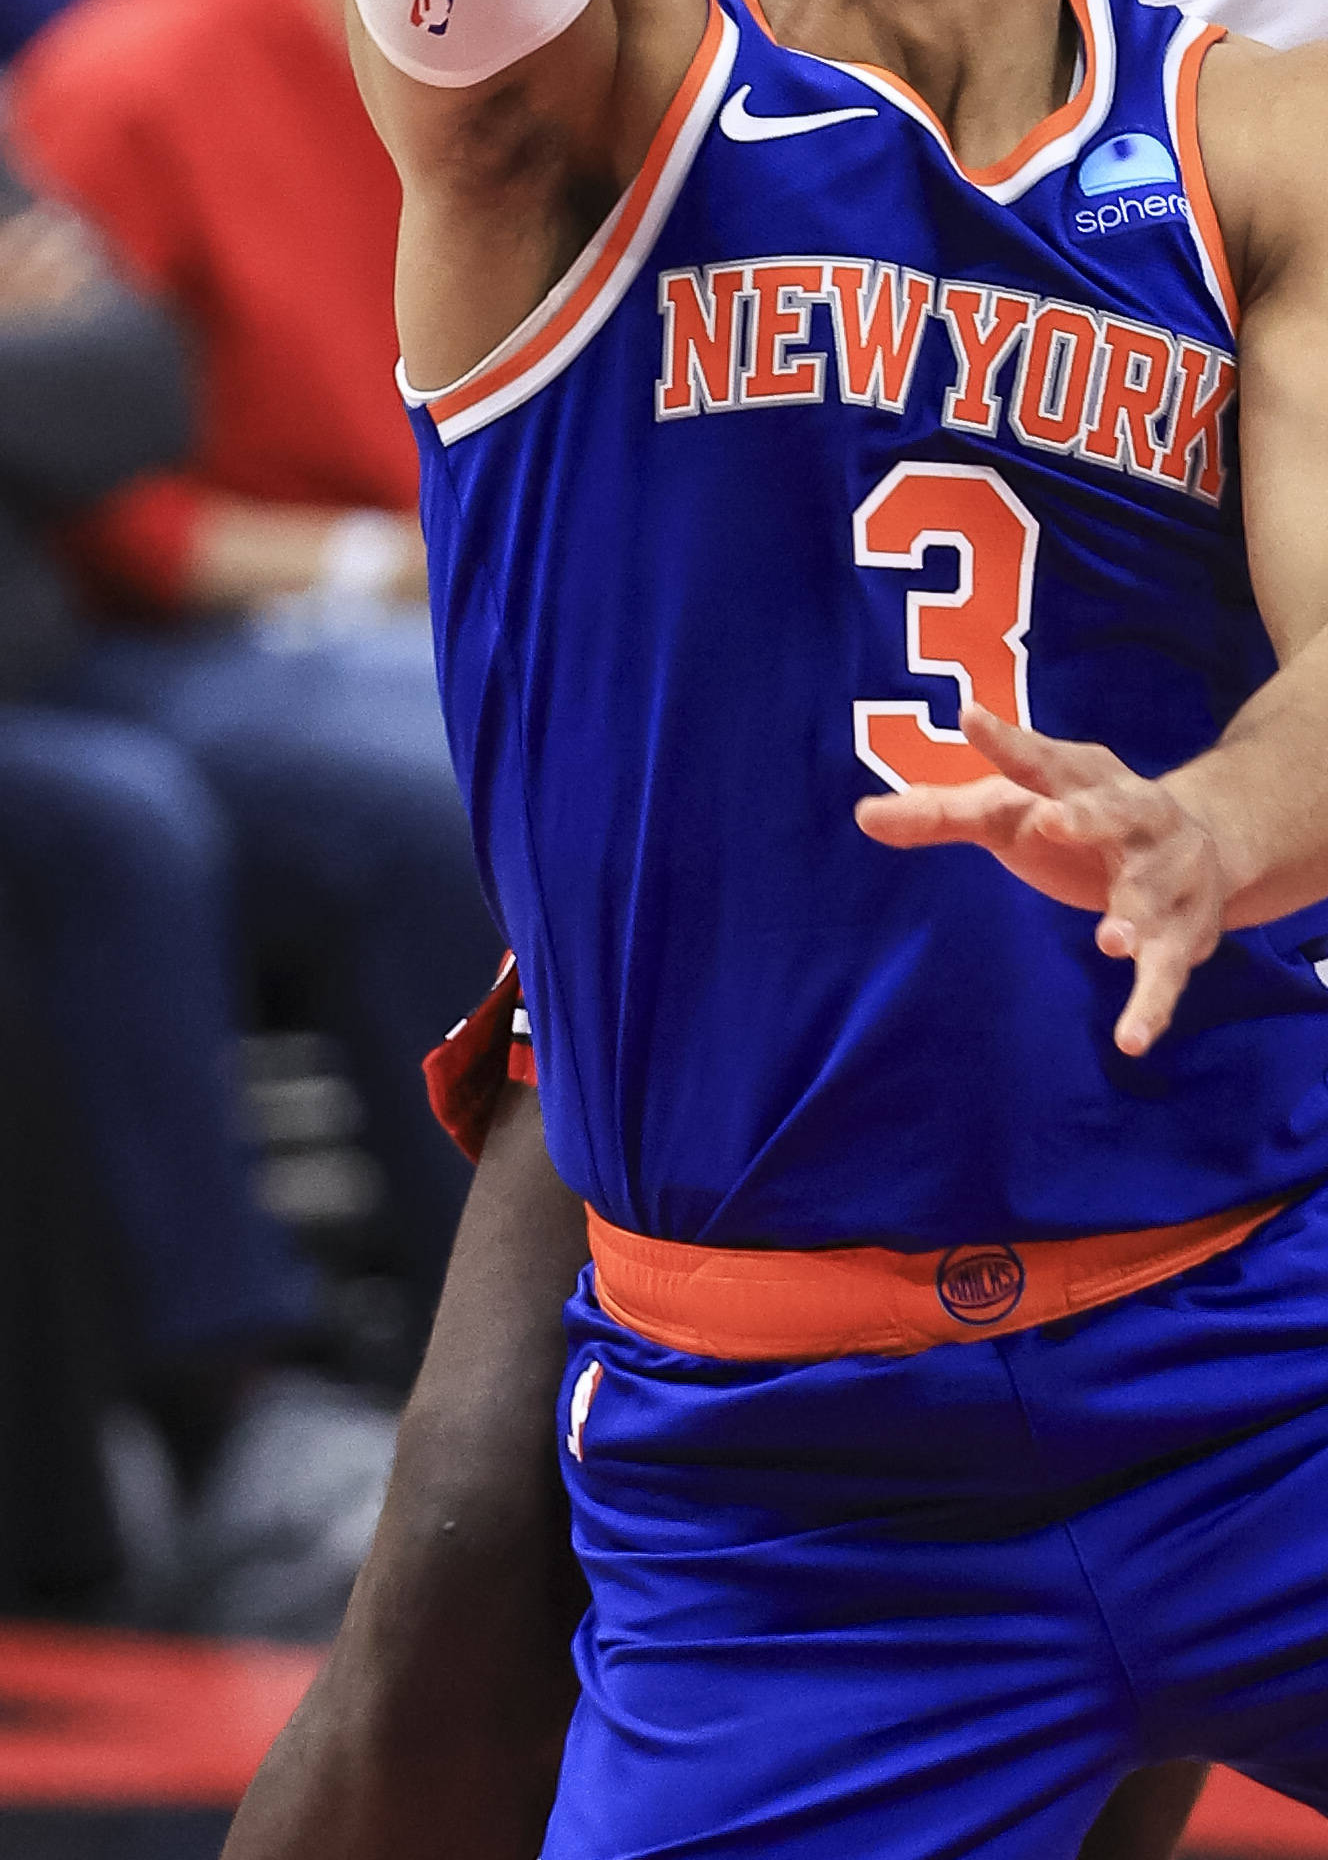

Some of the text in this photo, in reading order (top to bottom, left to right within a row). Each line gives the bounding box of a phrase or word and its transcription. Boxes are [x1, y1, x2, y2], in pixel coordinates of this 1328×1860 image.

[1074, 193, 1191, 235] sphere
[655, 255, 1237, 509] NEW YORK
[853, 460, 1040, 795] 3
